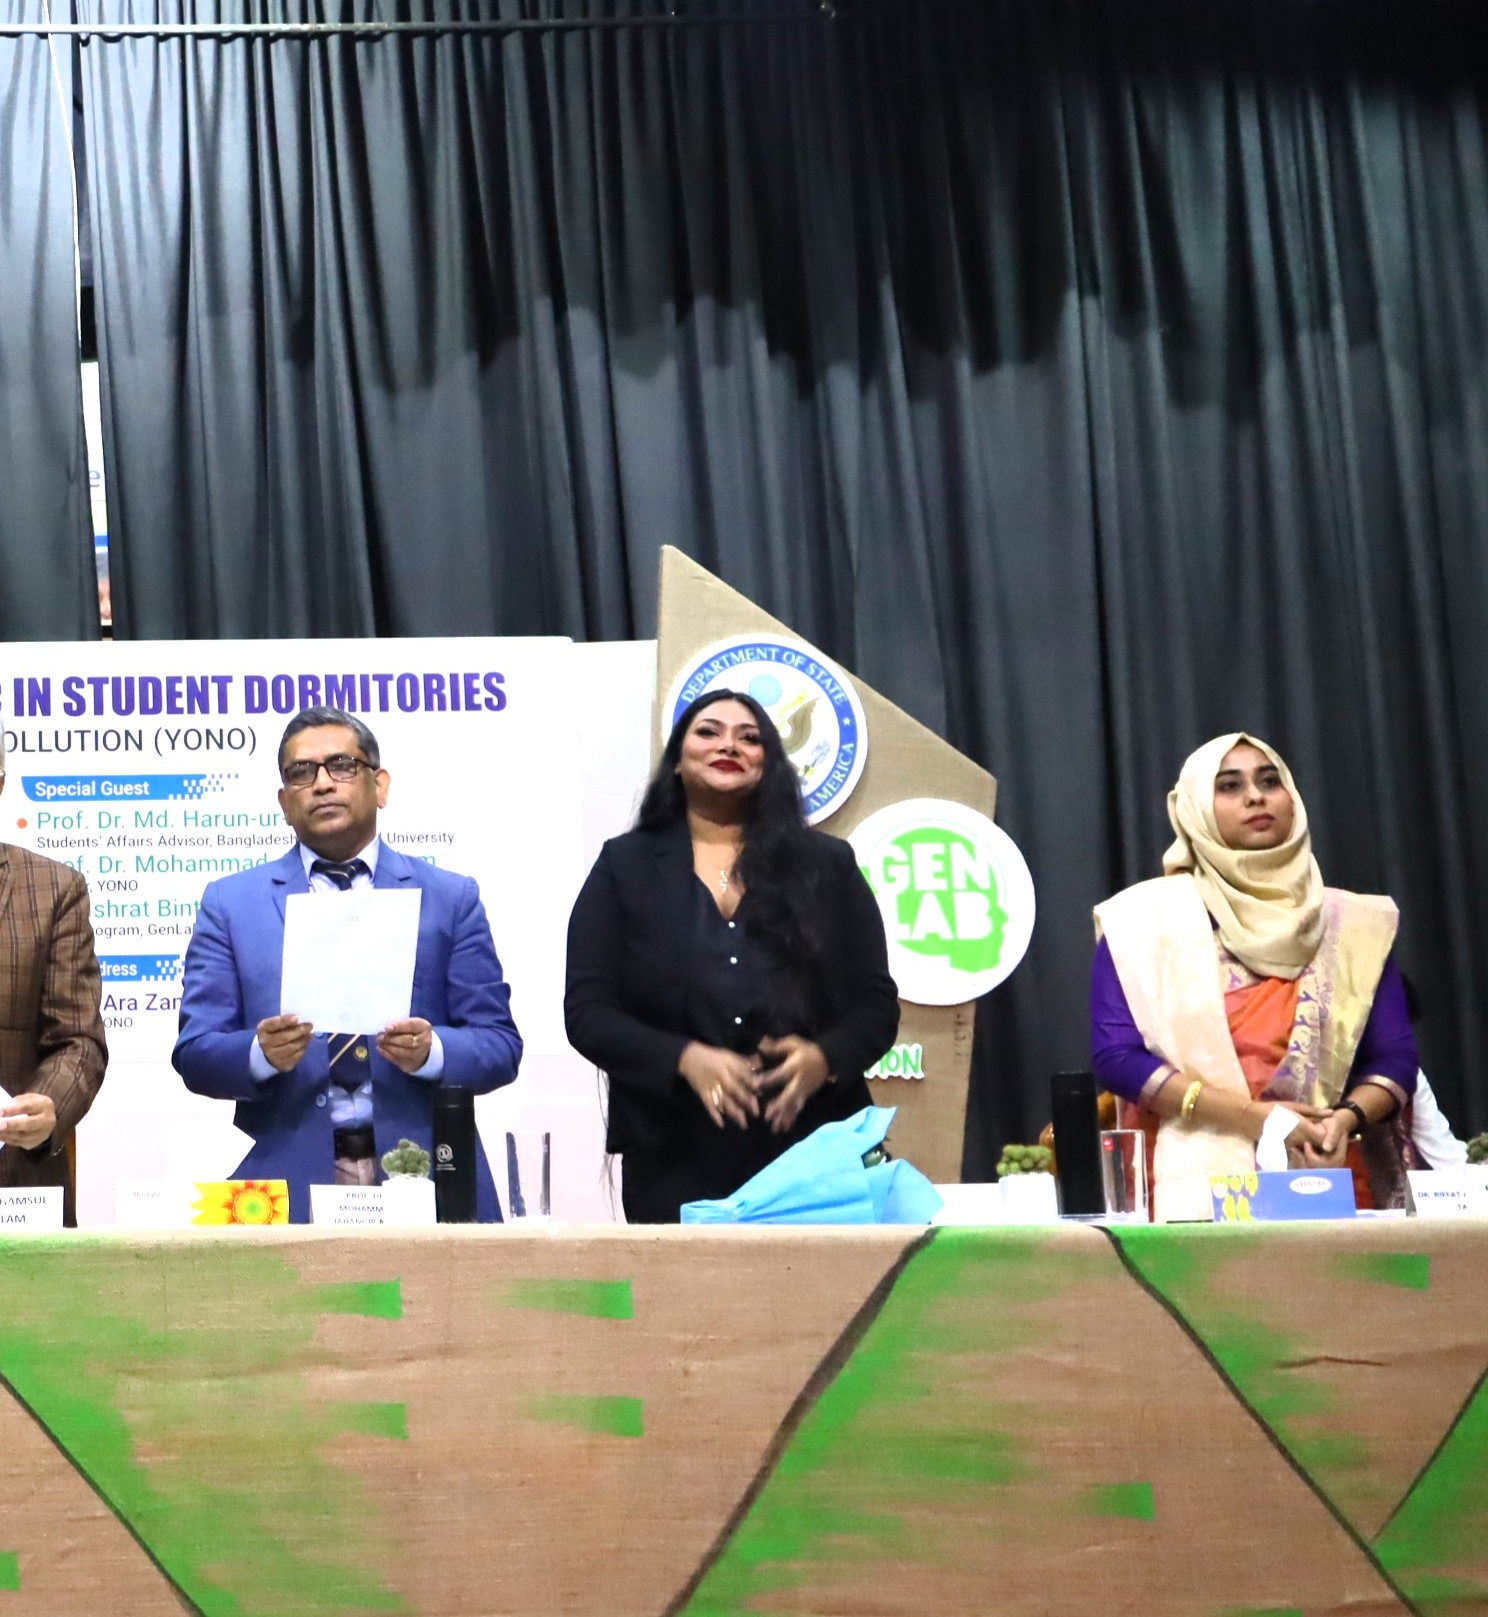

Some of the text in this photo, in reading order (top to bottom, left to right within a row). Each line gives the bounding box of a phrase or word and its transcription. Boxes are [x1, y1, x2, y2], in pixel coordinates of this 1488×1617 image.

[681, 647, 848, 705] DEPARTMENT OF STATE
[13, 677, 51, 717] IN
[62, 675, 233, 717] STUDENT
[244, 672, 507, 714] DORMITORIES
[4, 729, 142, 753] OLLUTION
[154, 726, 257, 756] (YONO)
[809, 743, 855, 809] AMERICA
[35, 780, 149, 799] Special Guest
[37, 811, 89, 830] Prof.
[98, 811, 125, 829] Dr.
[134, 810, 175, 829] Md.
[37, 832, 454, 849] Students' Affairs Advisor, Bangladesh University
[99, 855, 126, 874] Dr.
[874, 842, 991, 894] GEN
[97, 879, 138, 892] YONO
[888, 891, 993, 940] LAB
[103, 994, 138, 1011] Ara
[103, 1017, 133, 1028] ONO
